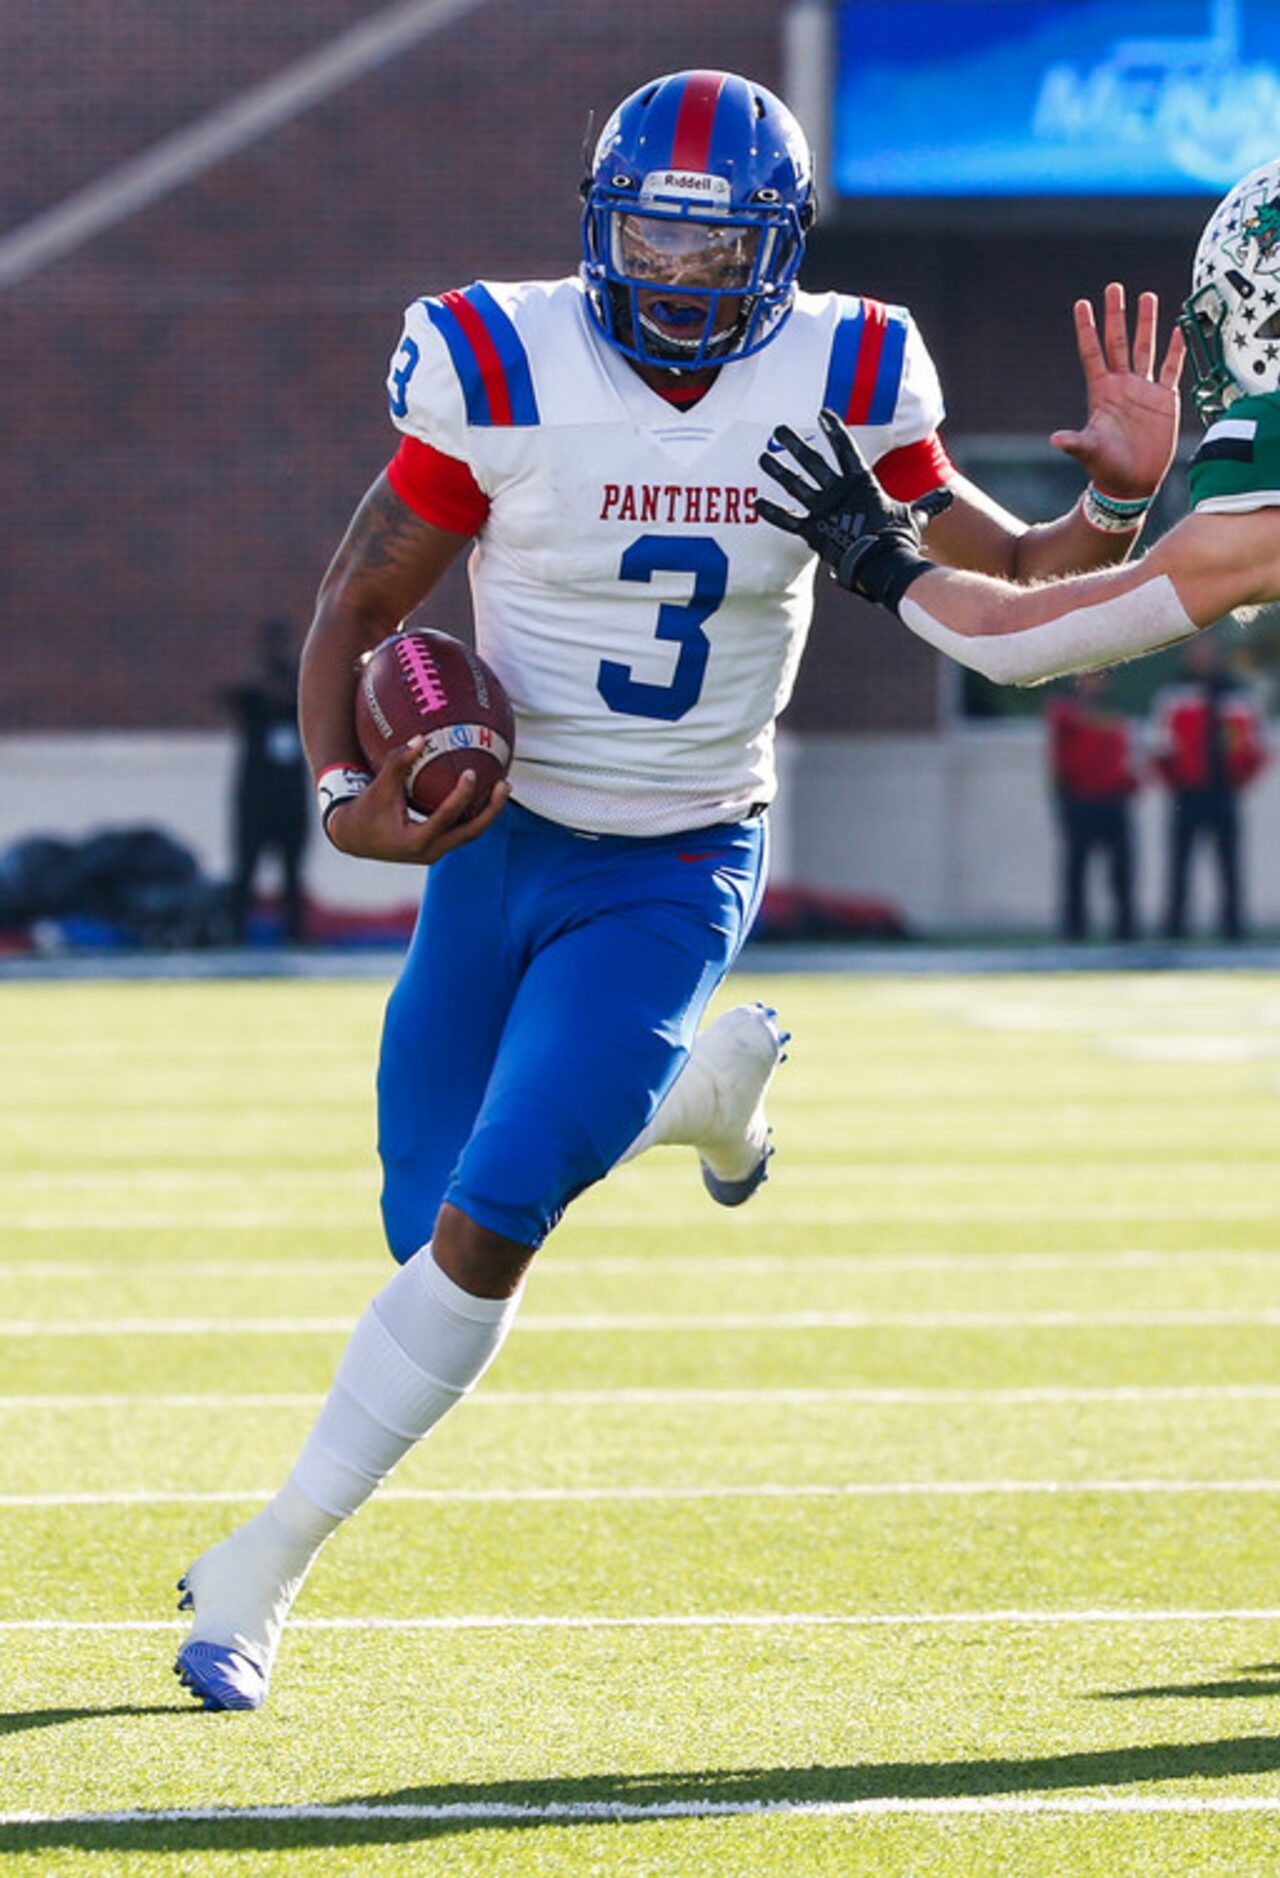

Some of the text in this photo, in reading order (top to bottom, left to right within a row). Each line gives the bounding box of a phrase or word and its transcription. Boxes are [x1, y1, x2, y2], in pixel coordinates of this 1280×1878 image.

[664, 174, 712, 191] Riddell
[390, 336, 420, 418] 3
[599, 484, 761, 524] PANTHERS
[596, 533, 729, 722] 3
